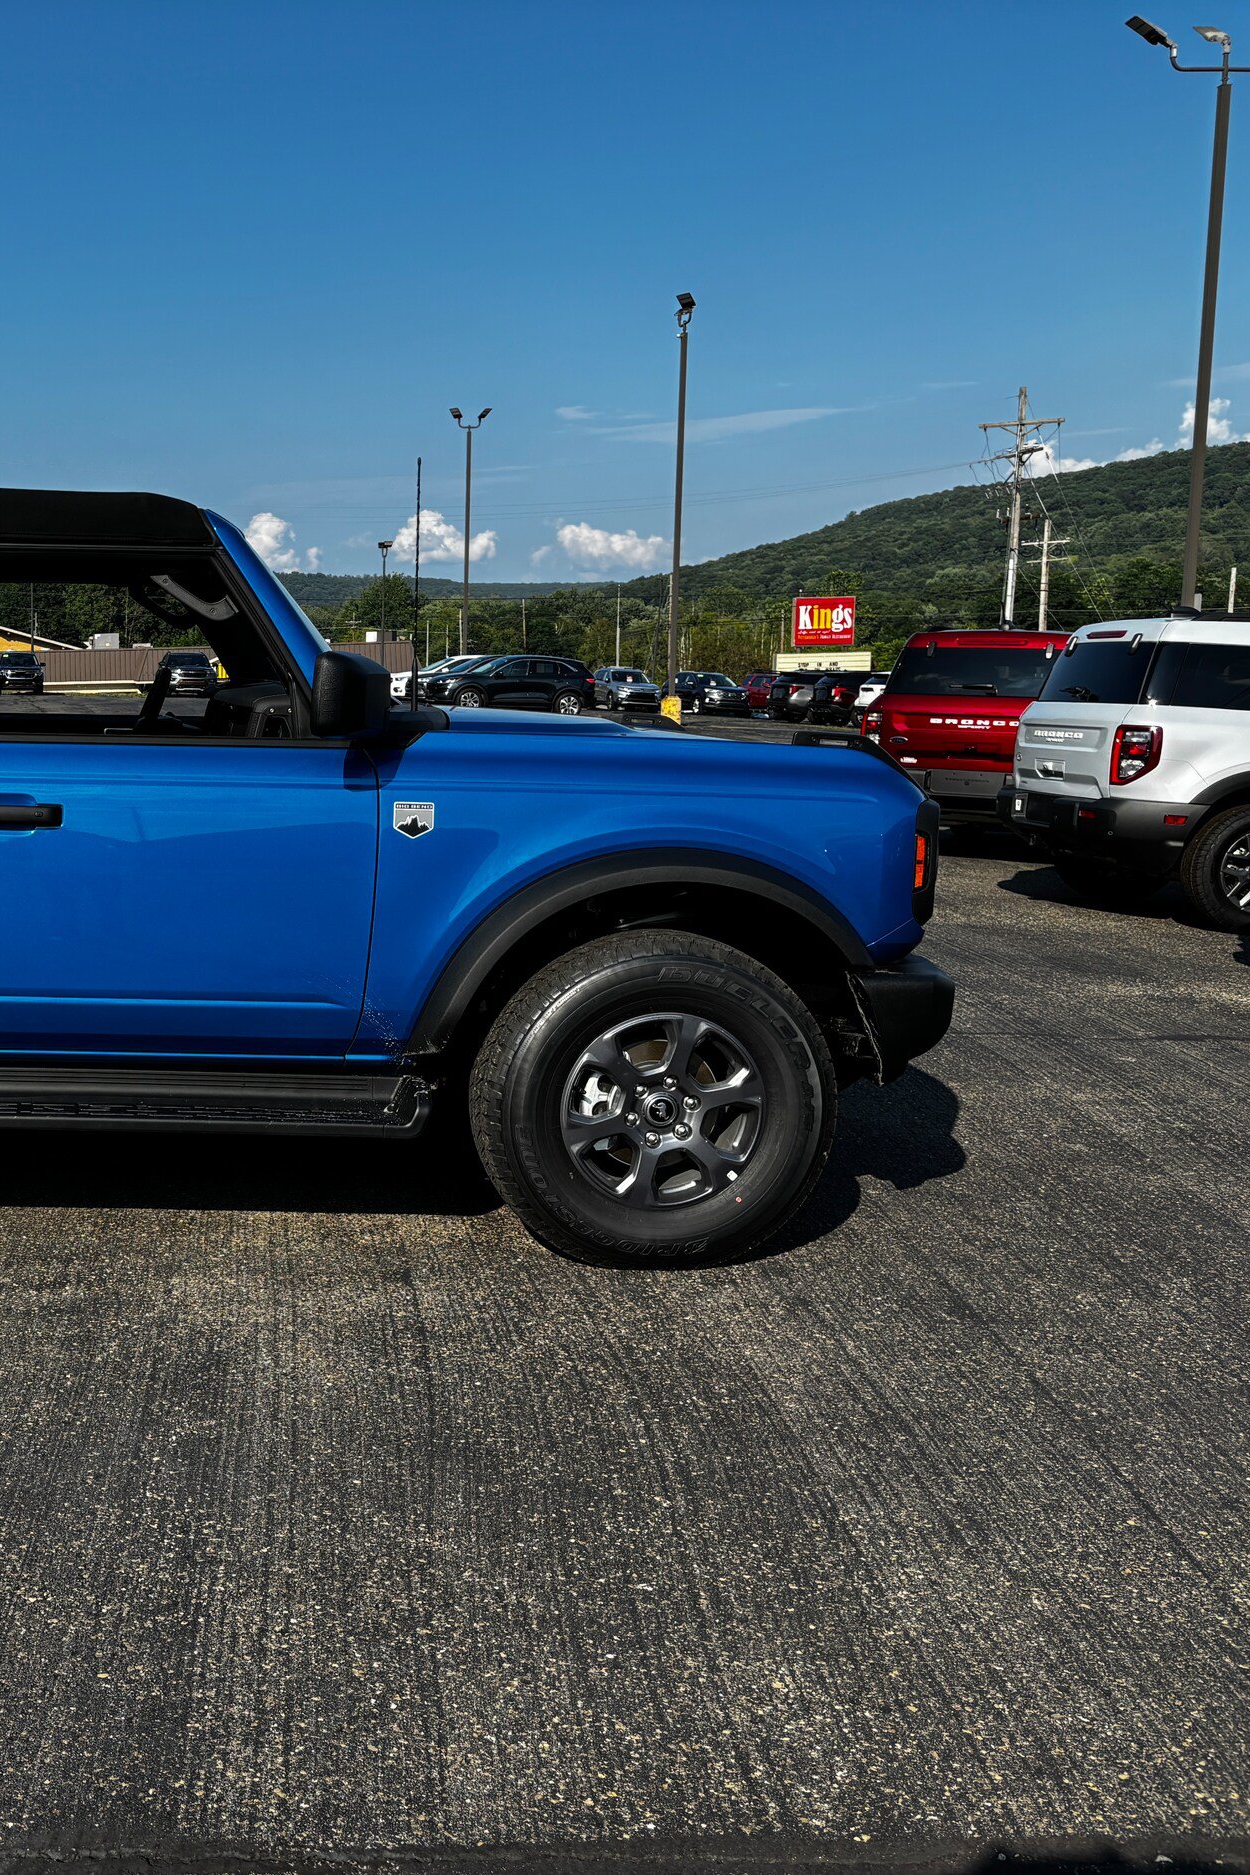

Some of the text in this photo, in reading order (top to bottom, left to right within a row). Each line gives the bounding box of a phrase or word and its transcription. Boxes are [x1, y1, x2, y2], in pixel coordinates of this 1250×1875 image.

[798, 604, 852, 633] Kings
[930, 718, 1019, 727] BRONCO
[1034, 730, 1084, 739] BRONCO
[658, 967, 812, 1071] DUELER
[515, 1122, 712, 1258] BRIDGESTONE
